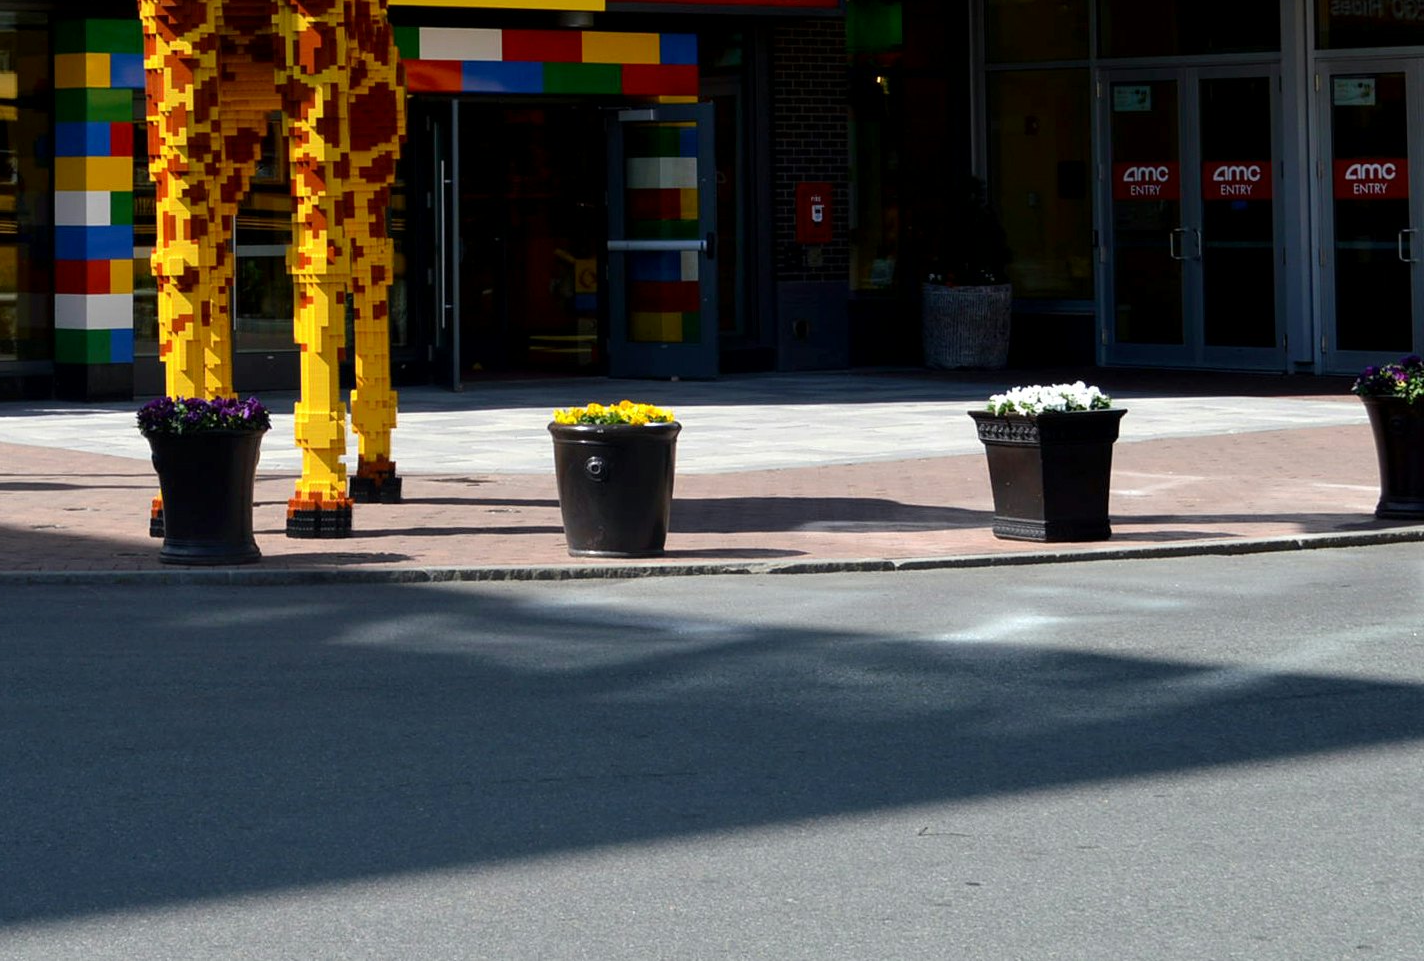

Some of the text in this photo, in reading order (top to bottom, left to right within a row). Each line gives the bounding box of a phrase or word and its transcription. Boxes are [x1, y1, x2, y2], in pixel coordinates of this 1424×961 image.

[1130, 185, 1161, 196] ENTRY
[1220, 185, 1253, 195] ENTRY
[1353, 183, 1388, 195] ENTRY
